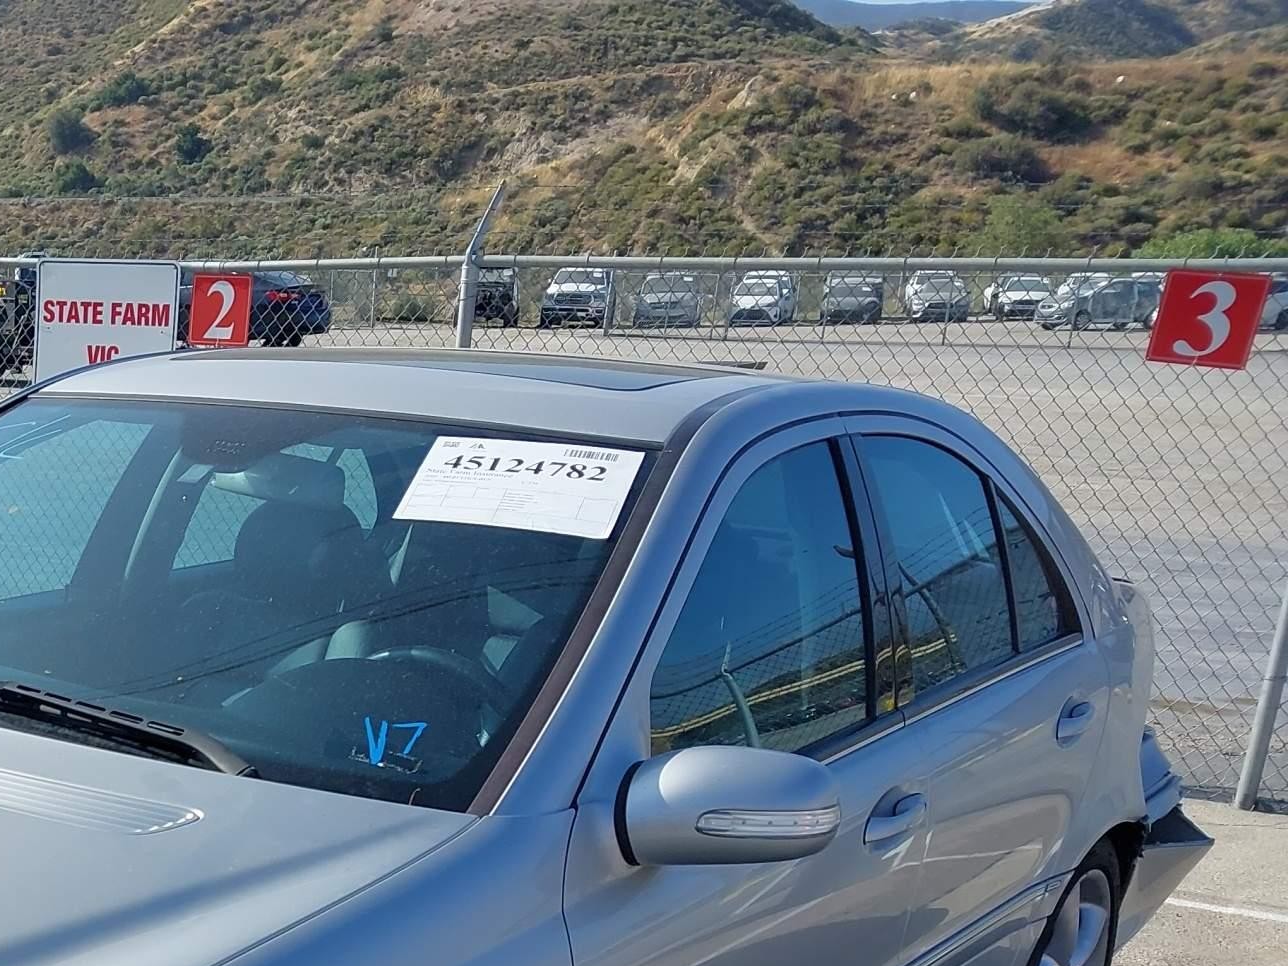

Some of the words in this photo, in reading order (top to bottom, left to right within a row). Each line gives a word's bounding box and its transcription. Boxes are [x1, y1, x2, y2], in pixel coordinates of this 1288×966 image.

[43, 300, 104, 325] STATE
[112, 303, 170, 327] FARM
[202, 280, 236, 340] 2
[1172, 280, 1237, 357] 3
[444, 455, 608, 482] 45124782
[364, 716, 428, 765] V7
